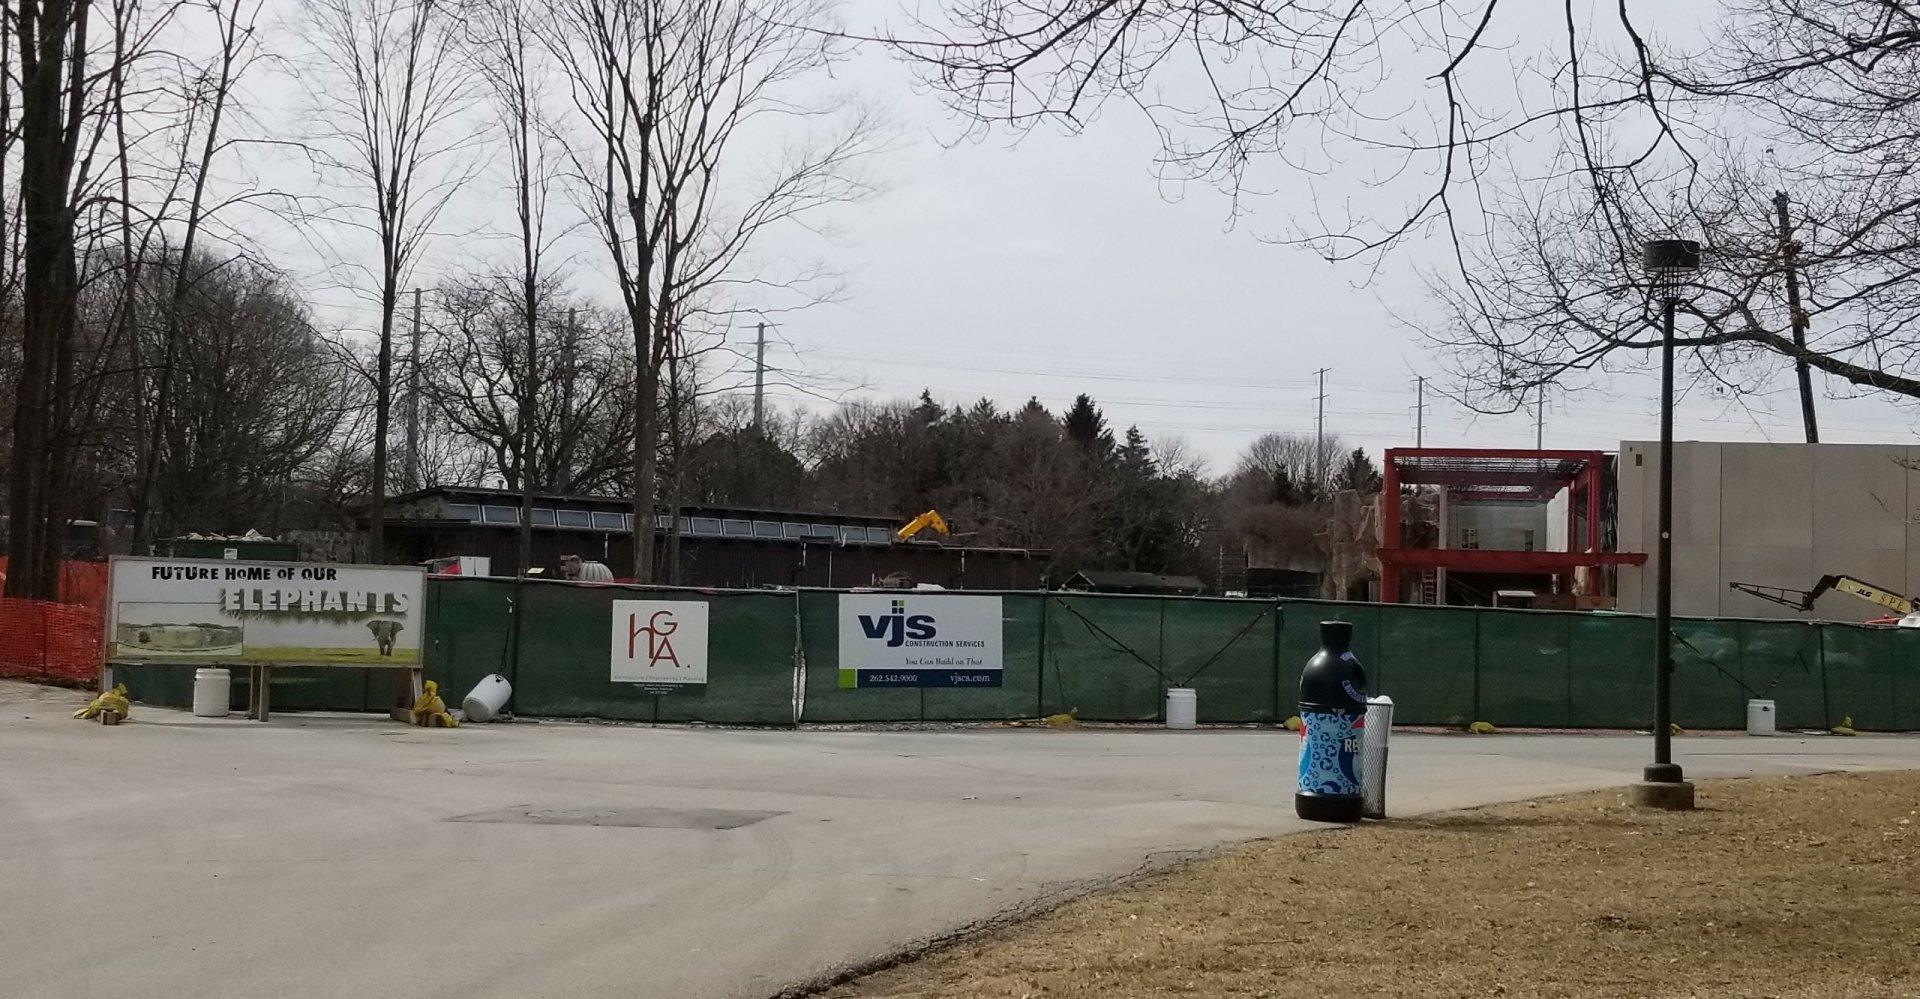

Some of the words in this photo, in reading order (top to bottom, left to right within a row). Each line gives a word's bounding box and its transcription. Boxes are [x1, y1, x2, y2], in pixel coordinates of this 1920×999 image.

[152, 566, 219, 580] FUTURE
[225, 567, 271, 580] HOME
[278, 569, 295, 580] OF
[302, 567, 337, 581] OUR
[1856, 588, 1872, 597] JLG
[224, 587, 410, 613] ELEPHANTS
[857, 599, 936, 647] vjs
[905, 640, 954, 648] CONSTRUCTION
[955, 640, 985, 648] SERVICES
[906, 657, 918, 665] You
[919, 657, 934, 665] Can
[935, 657, 954, 665] Build
[966, 657, 983, 665] That
[869, 674, 918, 682] 262.542.9000
[950, 673, 991, 685] vjscs.com
